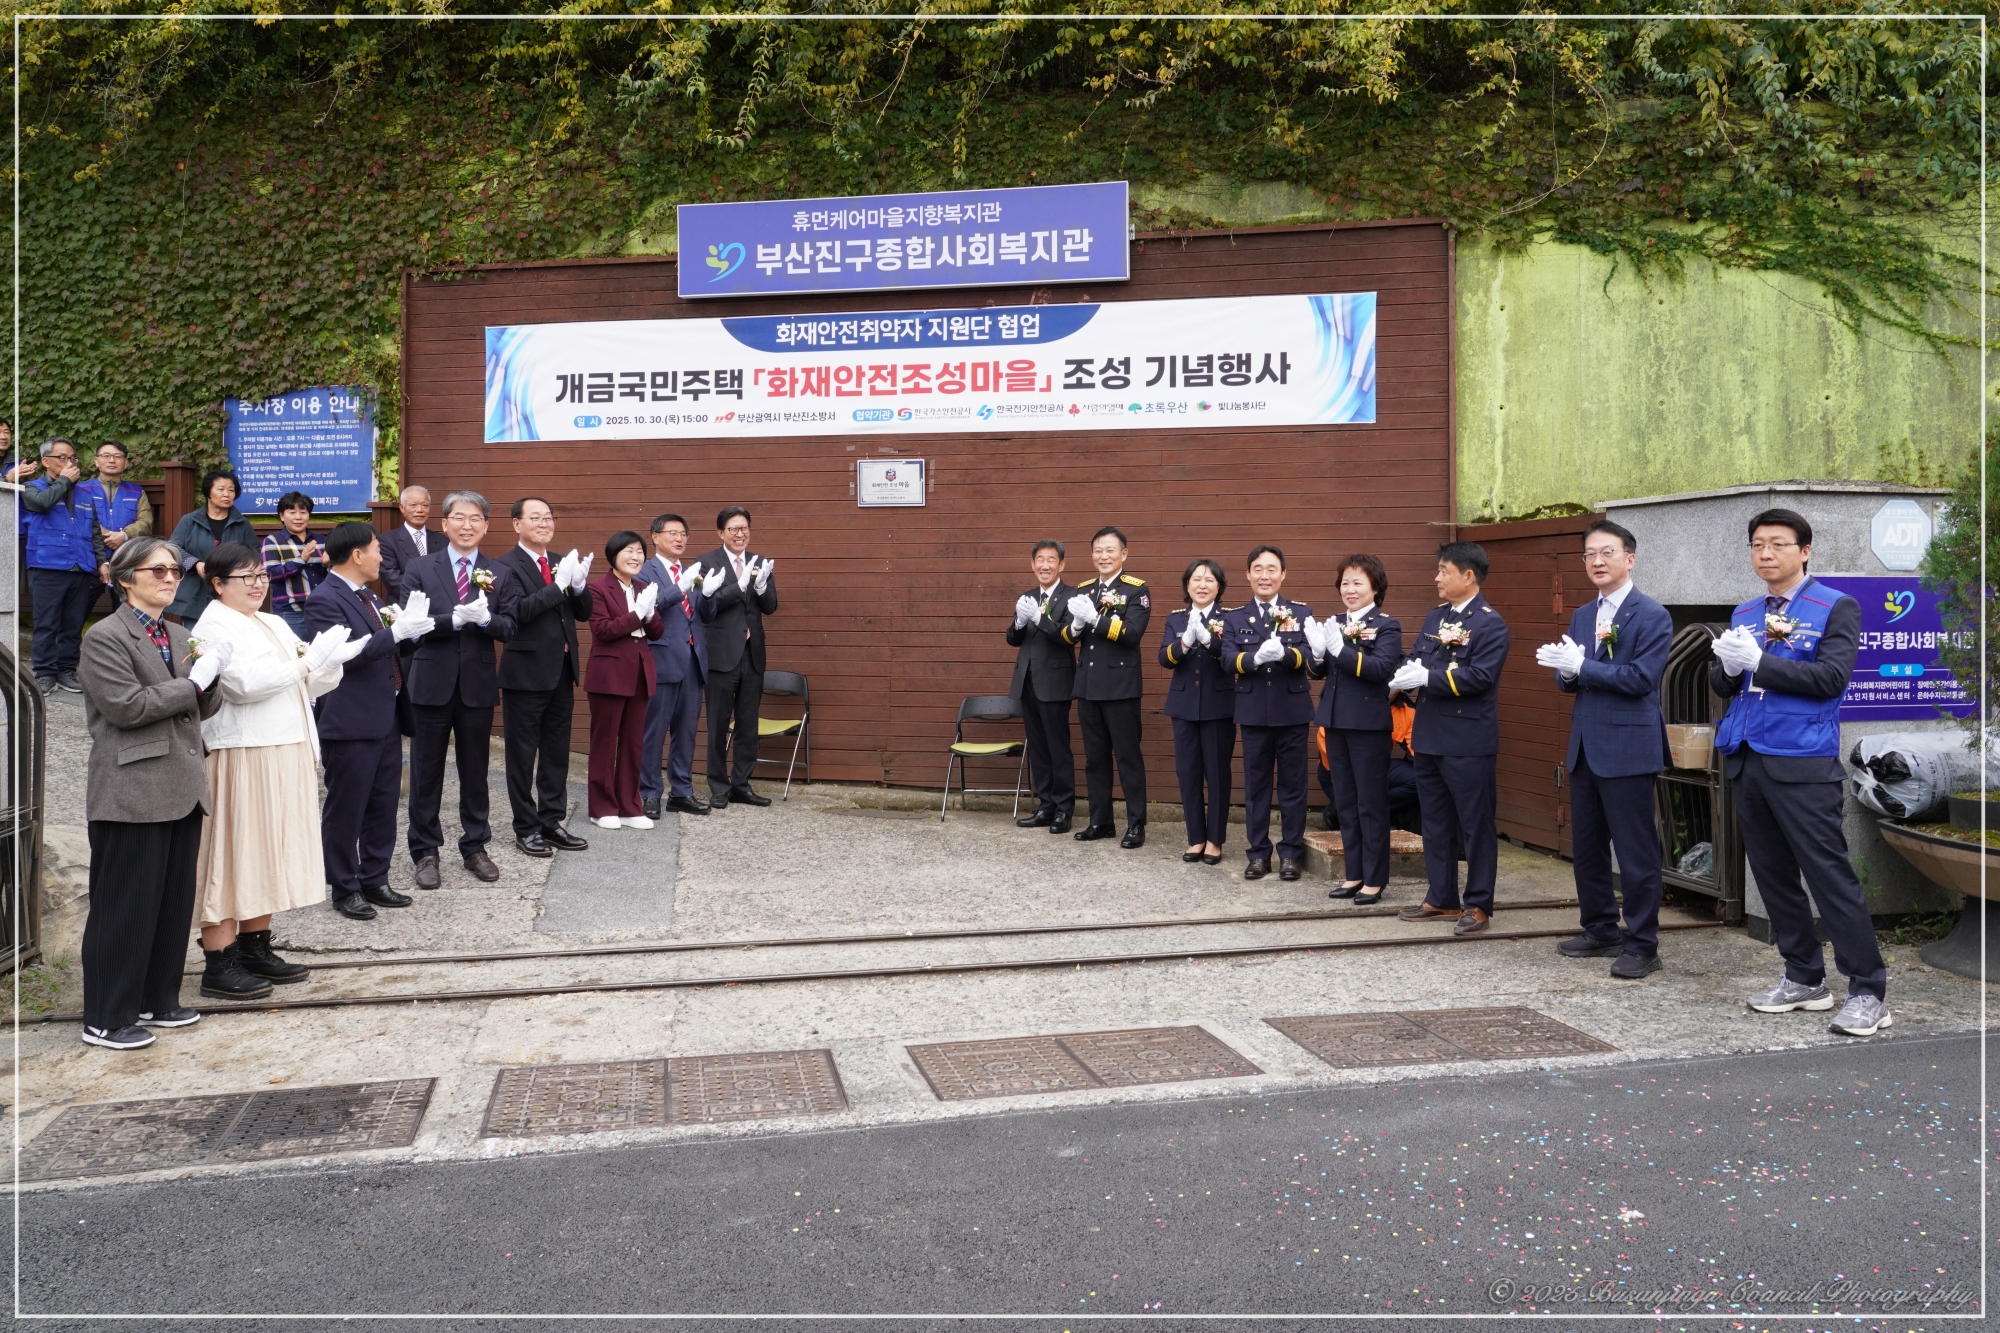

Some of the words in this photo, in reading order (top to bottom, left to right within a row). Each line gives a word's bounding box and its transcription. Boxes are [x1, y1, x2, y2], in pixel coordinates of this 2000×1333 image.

[792, 203, 1001, 231] 휴먼케어마을지향복지관
[755, 228, 1093, 276] 부산진구종합사회복지관
[776, 319, 922, 345] 화재안전취약자
[928, 315, 992, 341] 지원단
[998, 313, 1040, 339] 협업
[555, 369, 743, 403] 개금국민주택
[754, 358, 1052, 399] 「화재안전조성마을」
[1063, 357, 1131, 390] 조성
[1145, 352, 1291, 388] 기념행사
[291, 396, 322, 414] 이용
[329, 396, 359, 413] 안내
[997, 404, 1064, 414] 한국전기안전공사
[1145, 401, 1188, 414] 초록우산
[1218, 401, 1266, 411] 빛나눔봉사단
[682, 414, 708, 423] 15:00
[737, 412, 781, 423] 부산광역시
[783, 411, 836, 422] 부산진소방서
[855, 409, 891, 421] 협약기관
[914, 407, 971, 417] 한국가스안전공사
[1881, 523, 1922, 547] ADT
